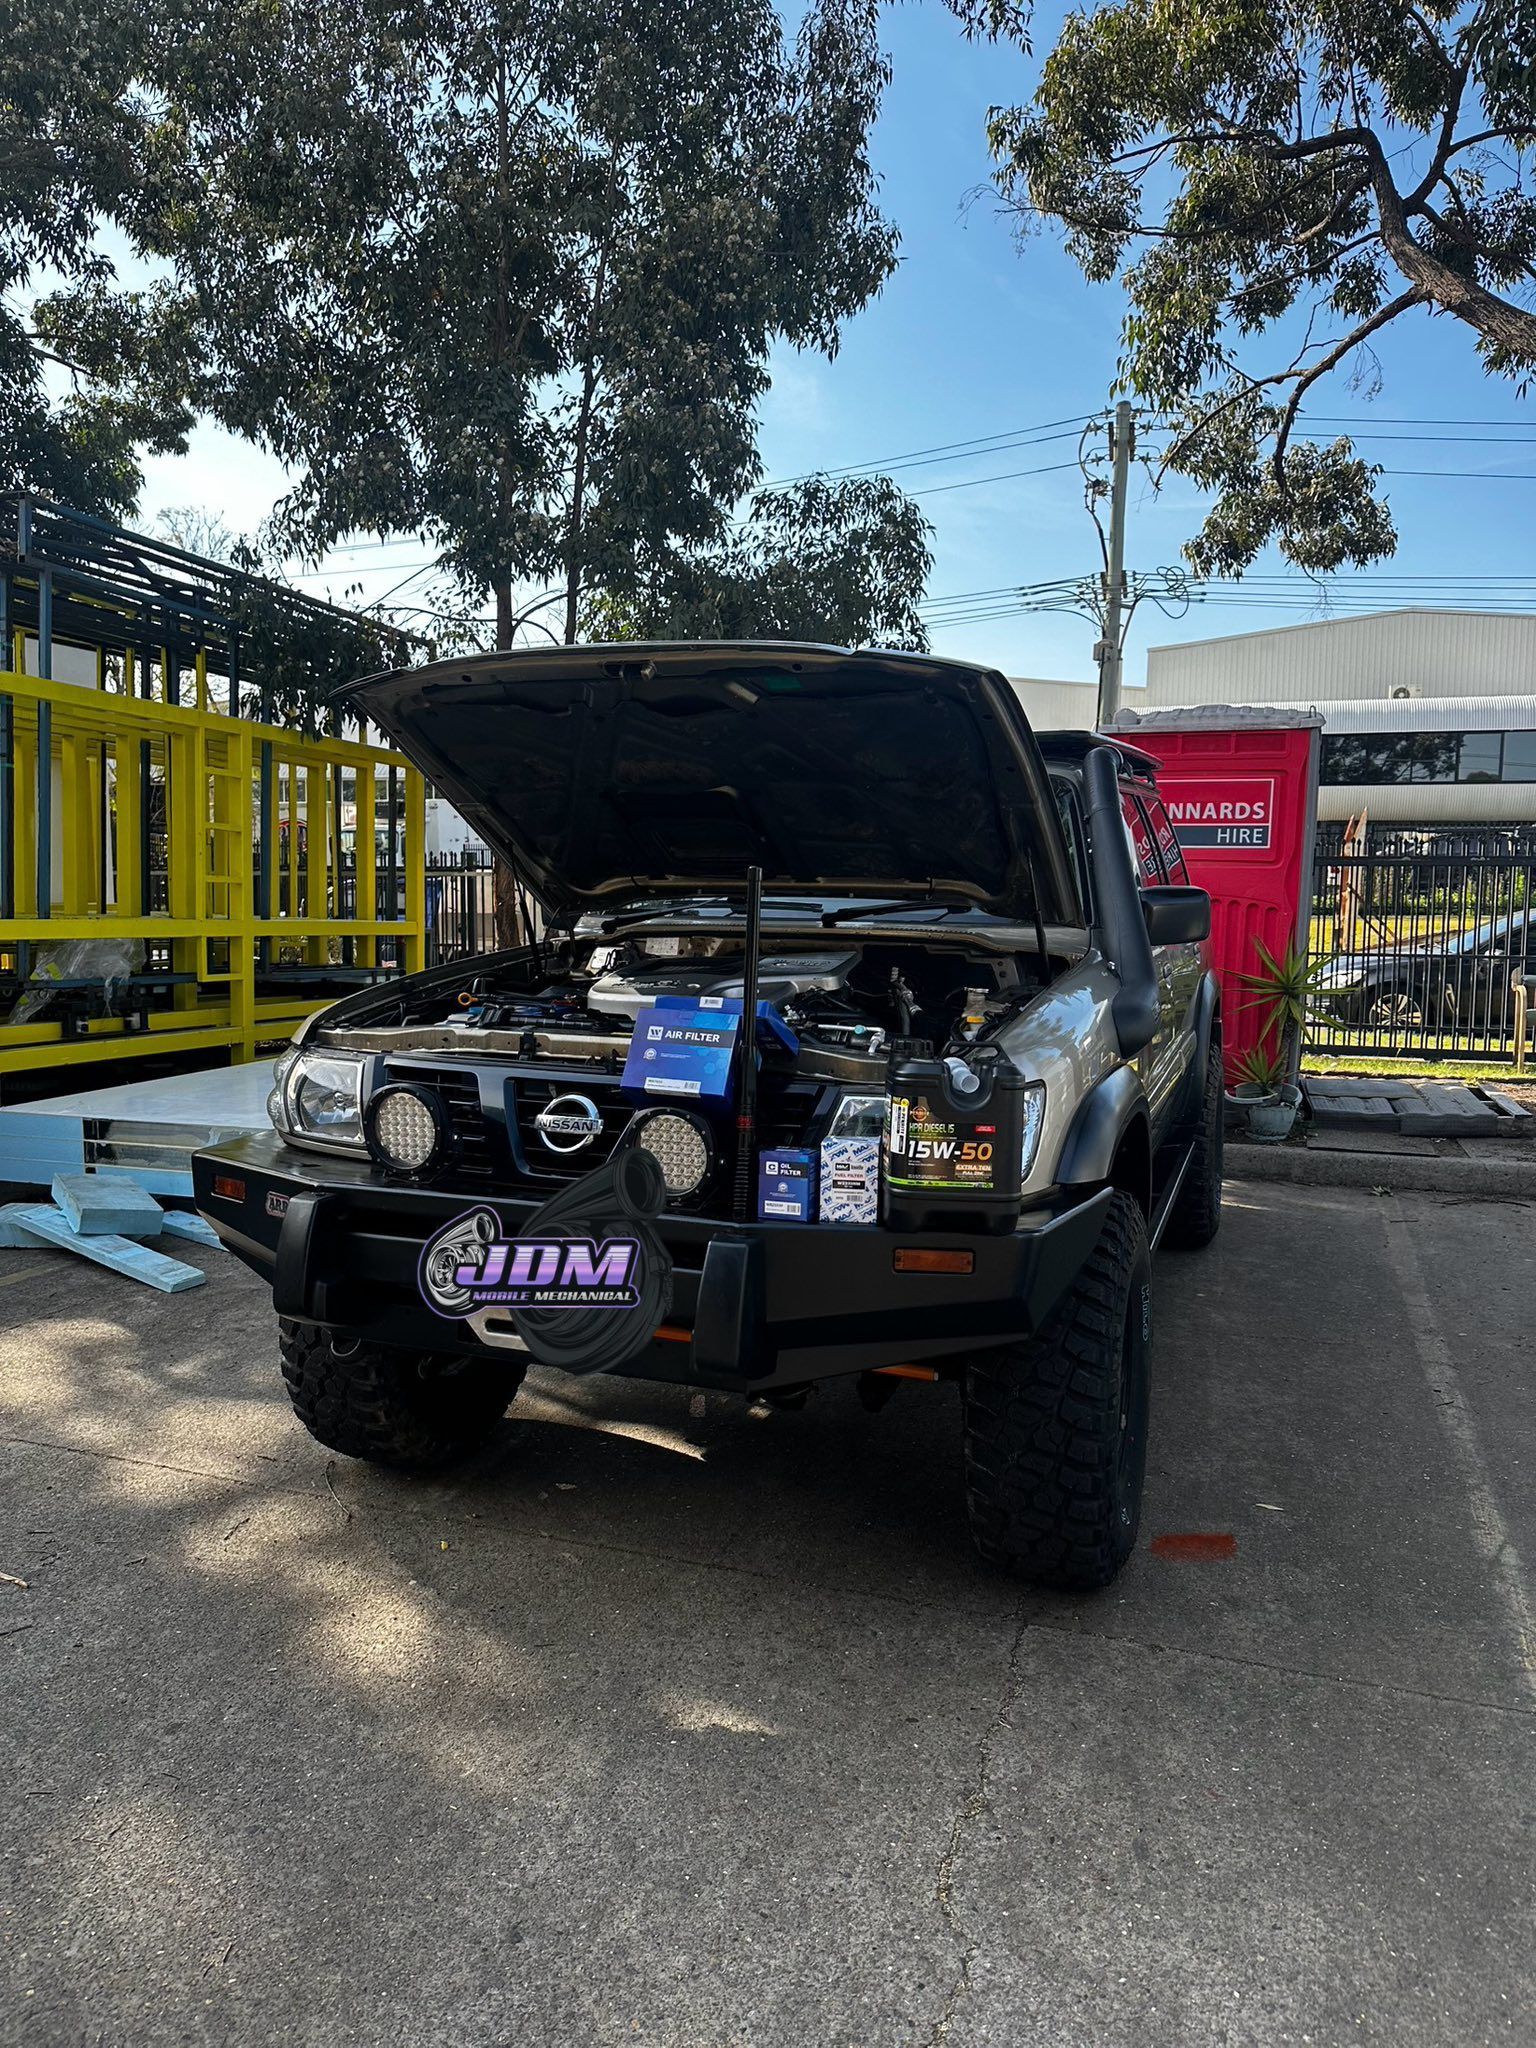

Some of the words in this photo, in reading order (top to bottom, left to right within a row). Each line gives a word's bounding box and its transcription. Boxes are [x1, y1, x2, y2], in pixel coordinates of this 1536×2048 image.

[1164, 802, 1265, 820] NNARDS
[1217, 828, 1263, 844] HIRE
[665, 1030, 683, 1040] AIR
[684, 1032, 720, 1043] FILTER
[538, 1119, 593, 1132] NISSAN
[923, 1123, 946, 1133] DIESEL
[908, 1140, 993, 1161] 15W-50
